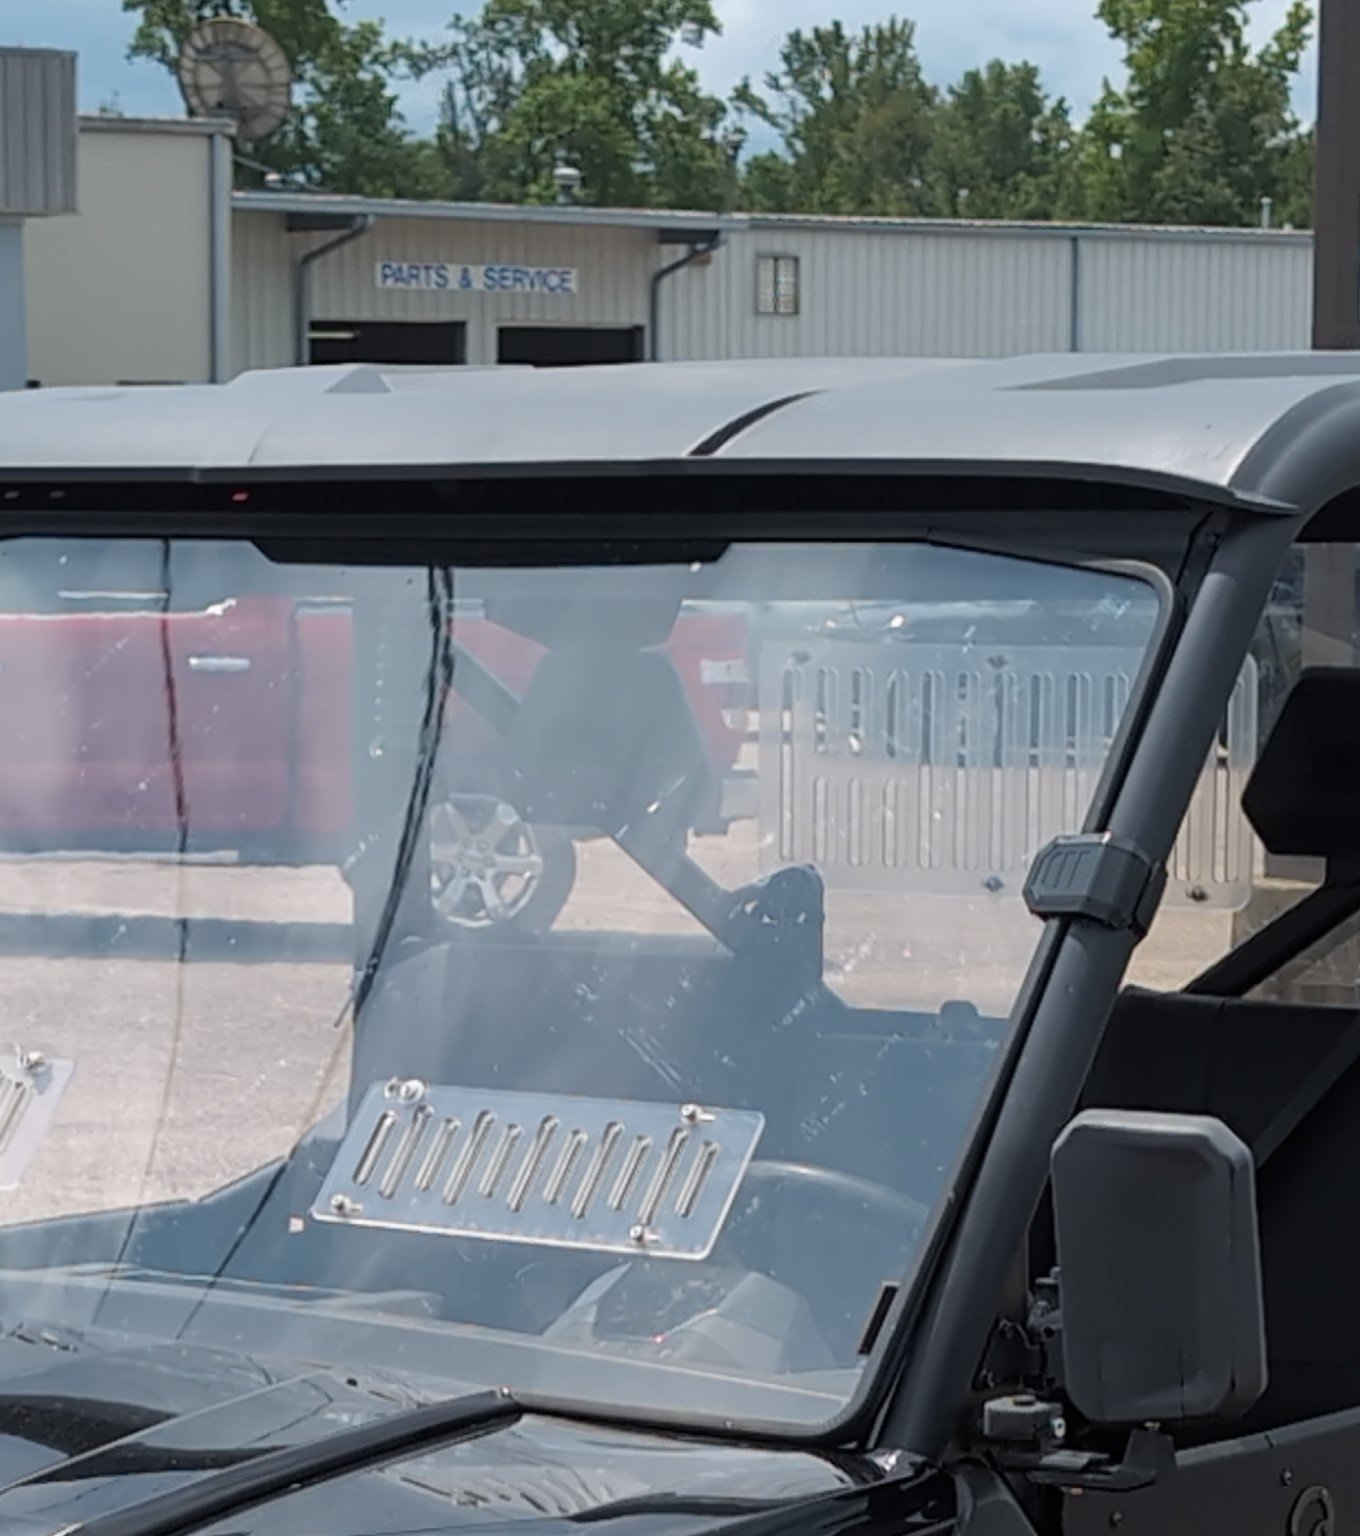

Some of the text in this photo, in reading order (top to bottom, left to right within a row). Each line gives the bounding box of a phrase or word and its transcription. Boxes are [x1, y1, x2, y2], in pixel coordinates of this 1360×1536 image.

[380, 262, 574, 292] PARTS & SERVICE
